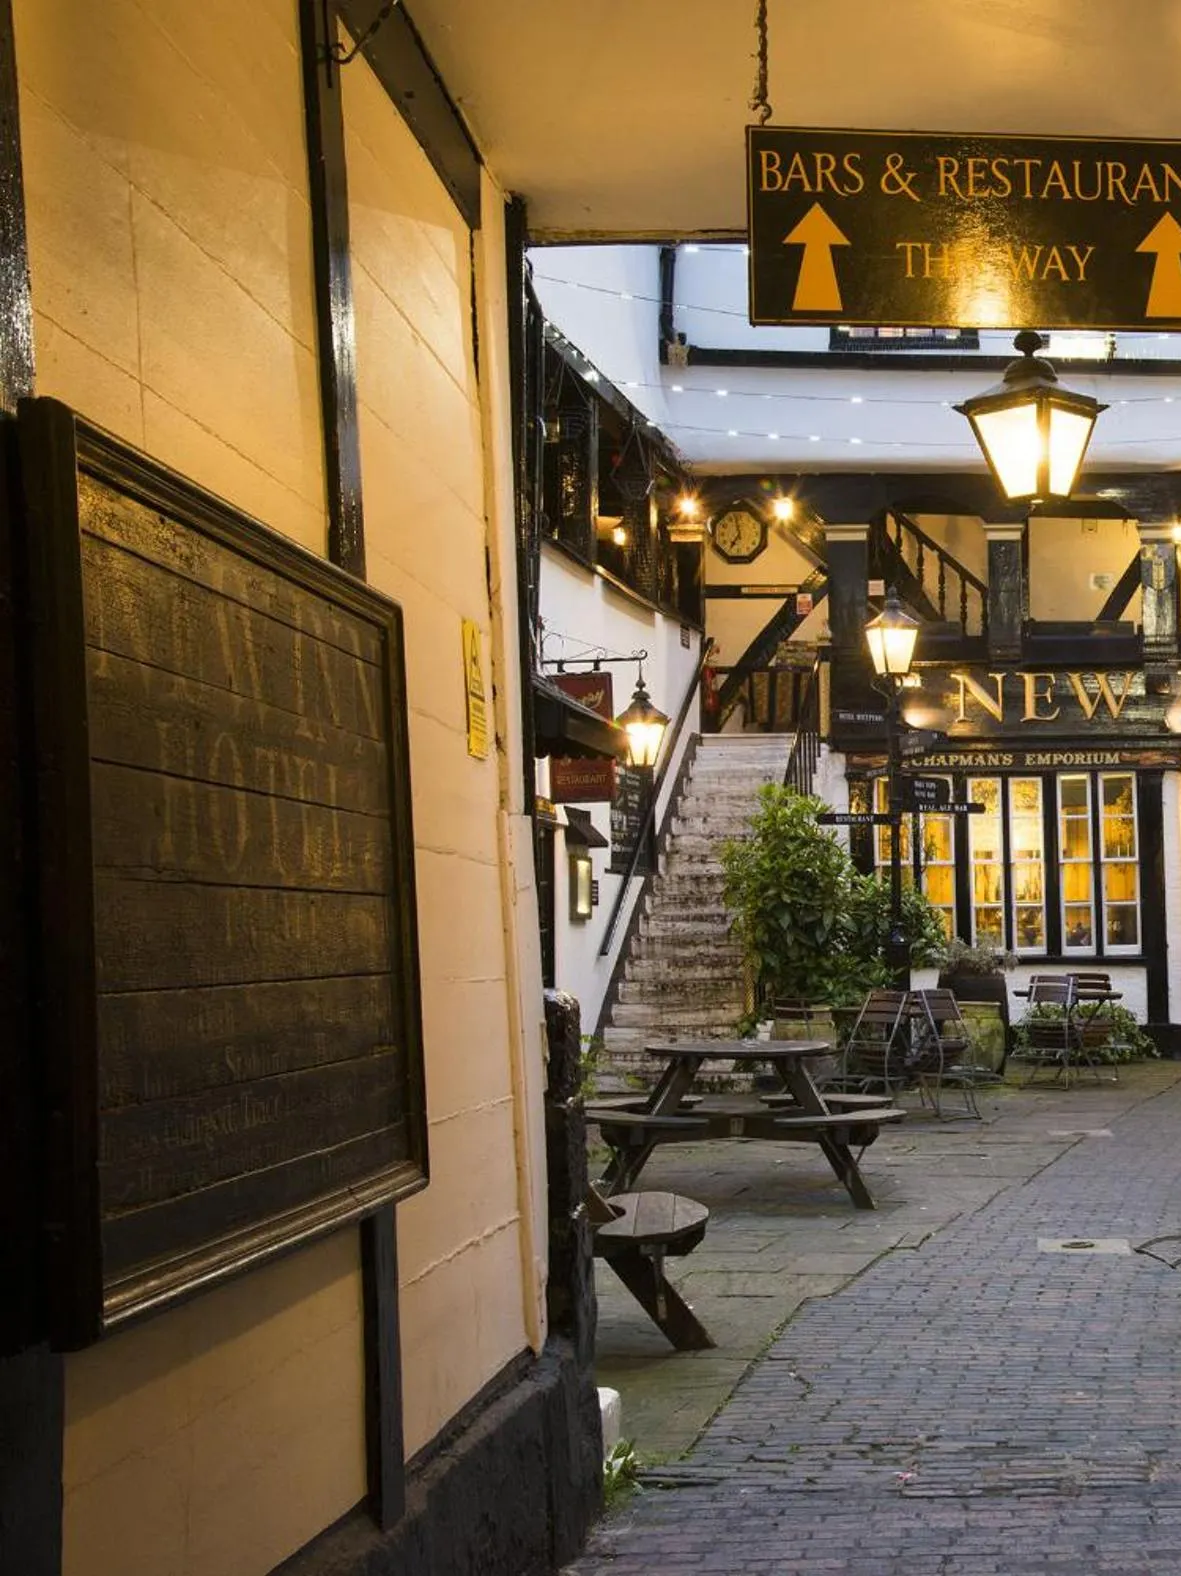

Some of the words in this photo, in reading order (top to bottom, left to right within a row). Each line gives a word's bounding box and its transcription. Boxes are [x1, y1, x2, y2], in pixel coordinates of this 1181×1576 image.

[759, 150, 865, 197] BARS
[879, 152, 921, 202] &
[895, 241, 985, 280] TH
[1005, 244, 1096, 282] WAY
[949, 671, 1135, 723] NEW
[1024, 751, 1120, 767] EMPORIUM
